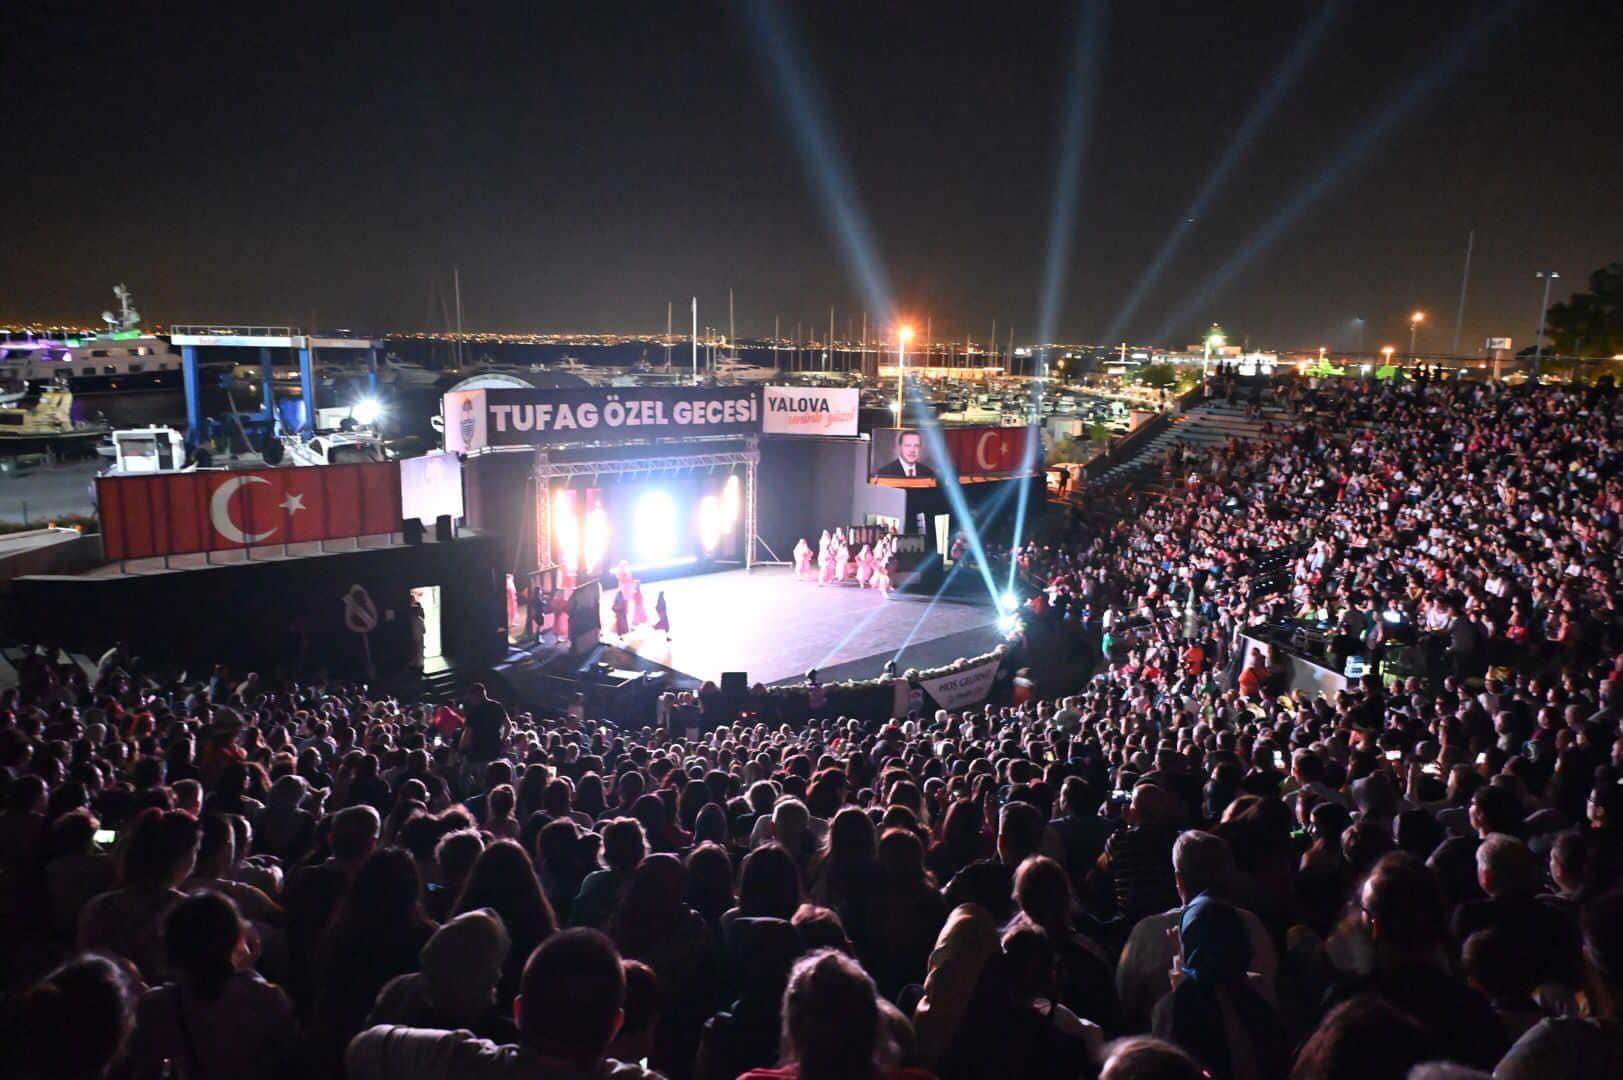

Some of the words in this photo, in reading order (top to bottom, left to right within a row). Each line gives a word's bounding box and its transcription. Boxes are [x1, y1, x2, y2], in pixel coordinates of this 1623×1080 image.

[489, 402, 599, 432] TUFAG
[603, 394, 669, 427] ÖZEL
[672, 392, 757, 424] GECESİ
[768, 397, 830, 413] YALOVA
